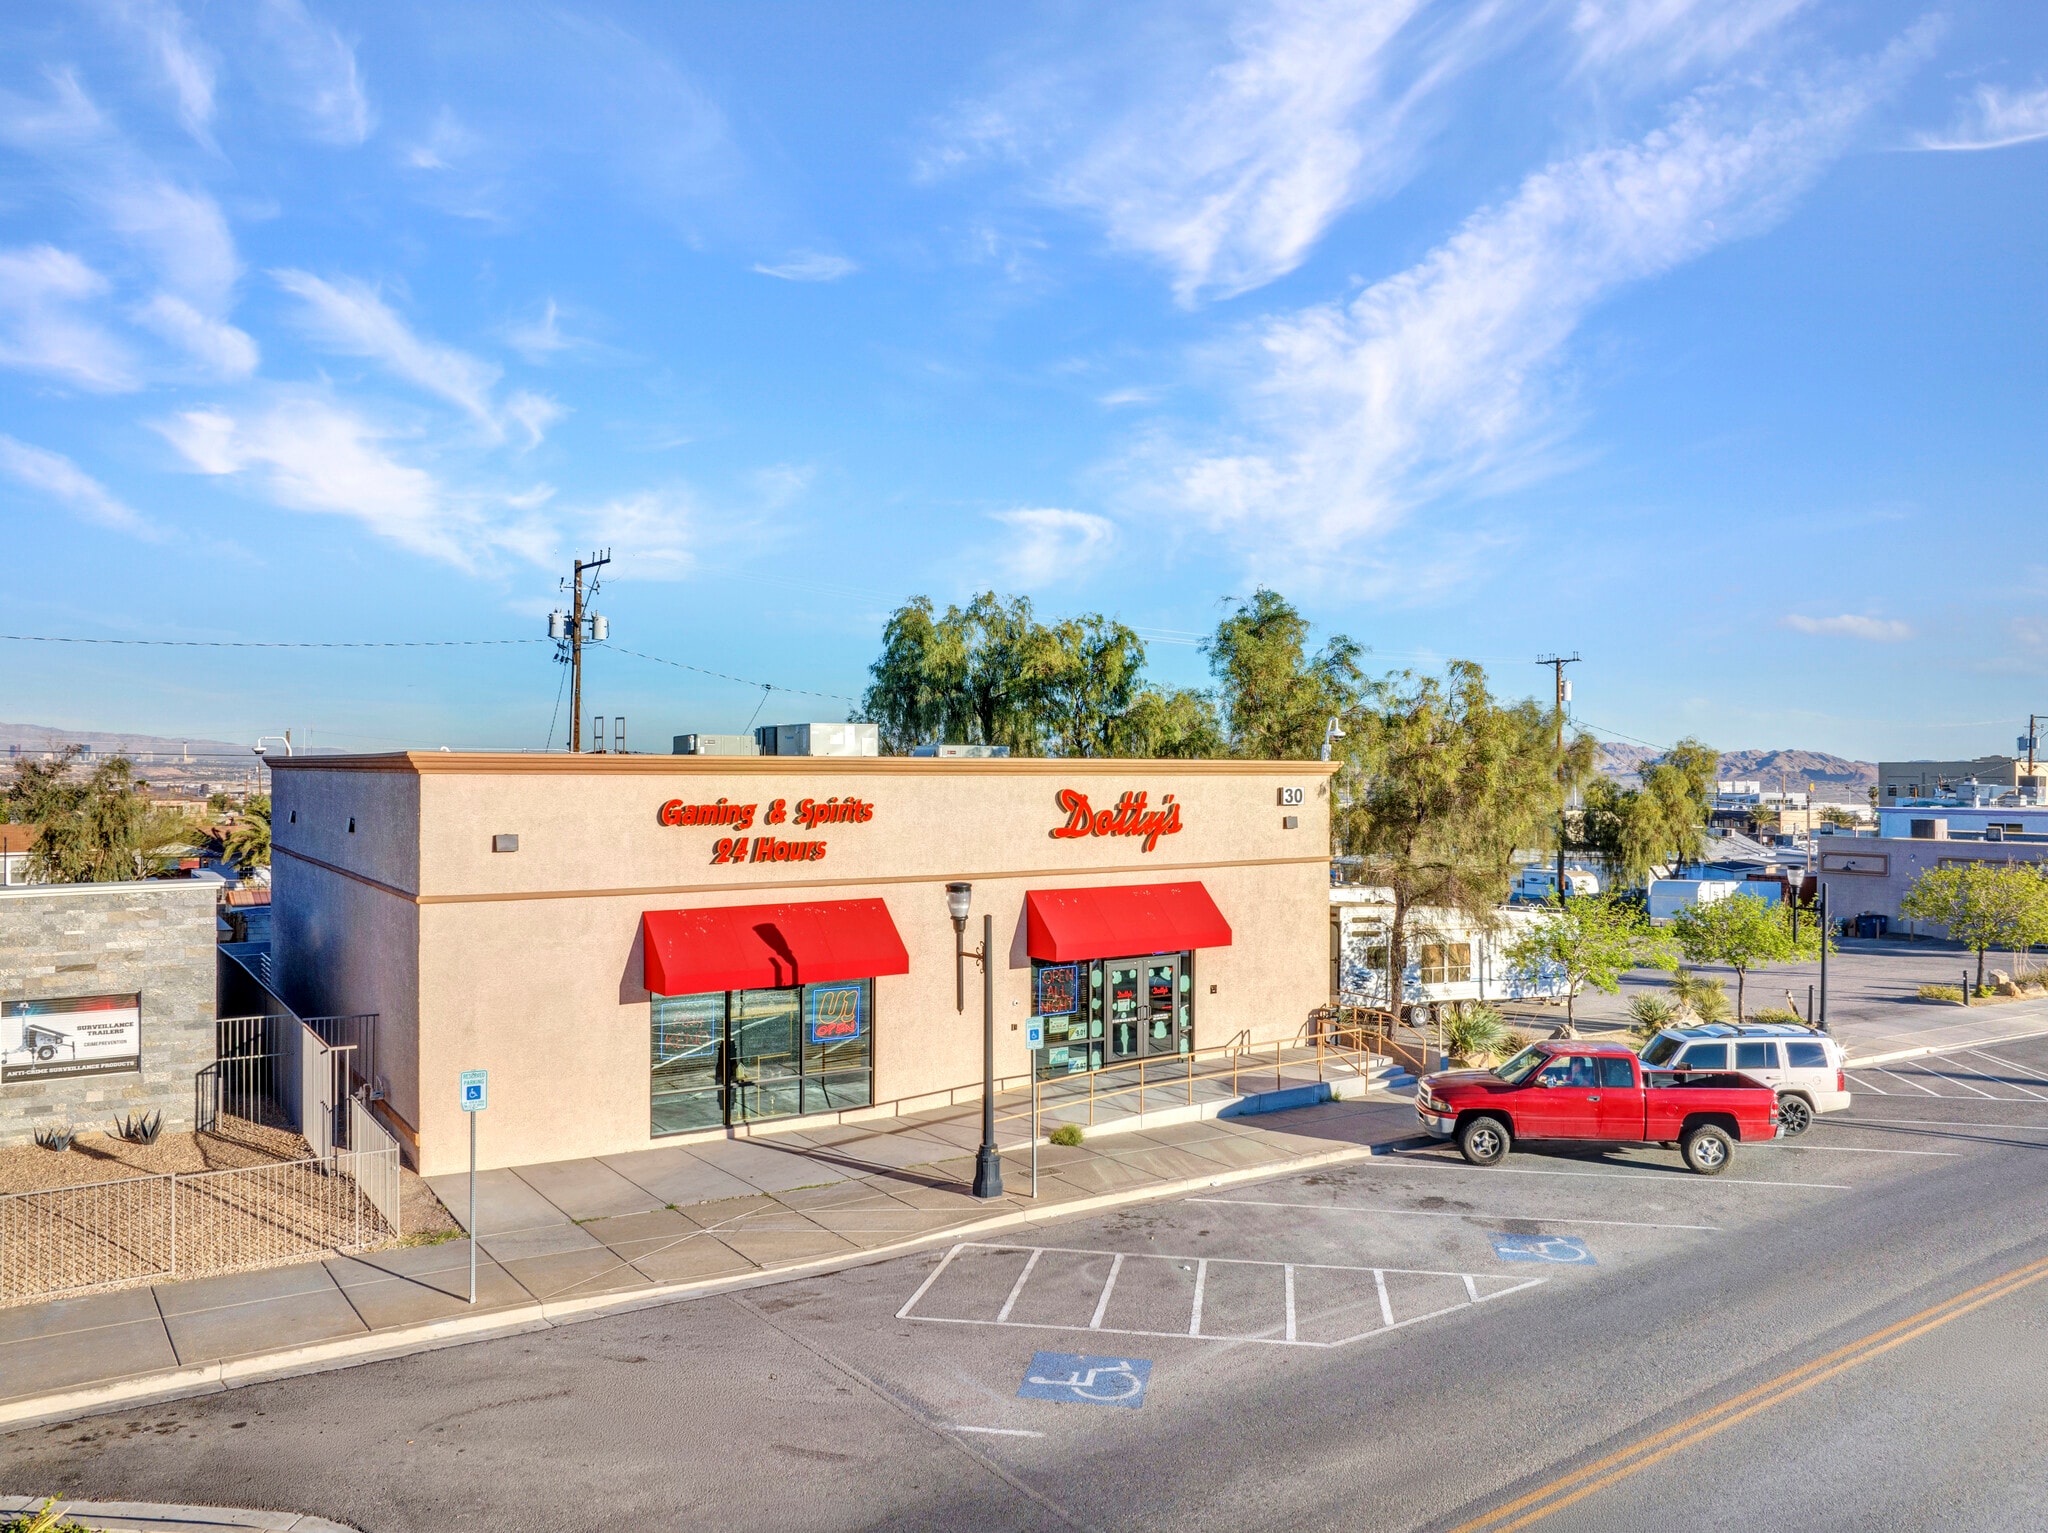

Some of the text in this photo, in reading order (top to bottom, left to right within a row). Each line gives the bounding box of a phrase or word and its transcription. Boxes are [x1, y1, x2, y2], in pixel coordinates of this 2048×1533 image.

[1284, 788, 1303, 803] 30
[657, 796, 874, 831] Gaming & Spirits
[1048, 789, 1182, 853] Dotty's
[709, 836, 827, 865] 24 Hours
[1042, 968, 1074, 985] OPEN
[1047, 985, 1070, 998] ALL
[1040, 996, 1074, 1013] NIGHT
[77, 1022, 134, 1030] SURVEILLANCE
[87, 1028, 124, 1036] TRAILERS
[816, 1020, 855, 1036] OPEN
[7, 1061, 135, 1077] ANTI-CRIME SURVEILLANCE PRODUCTS
